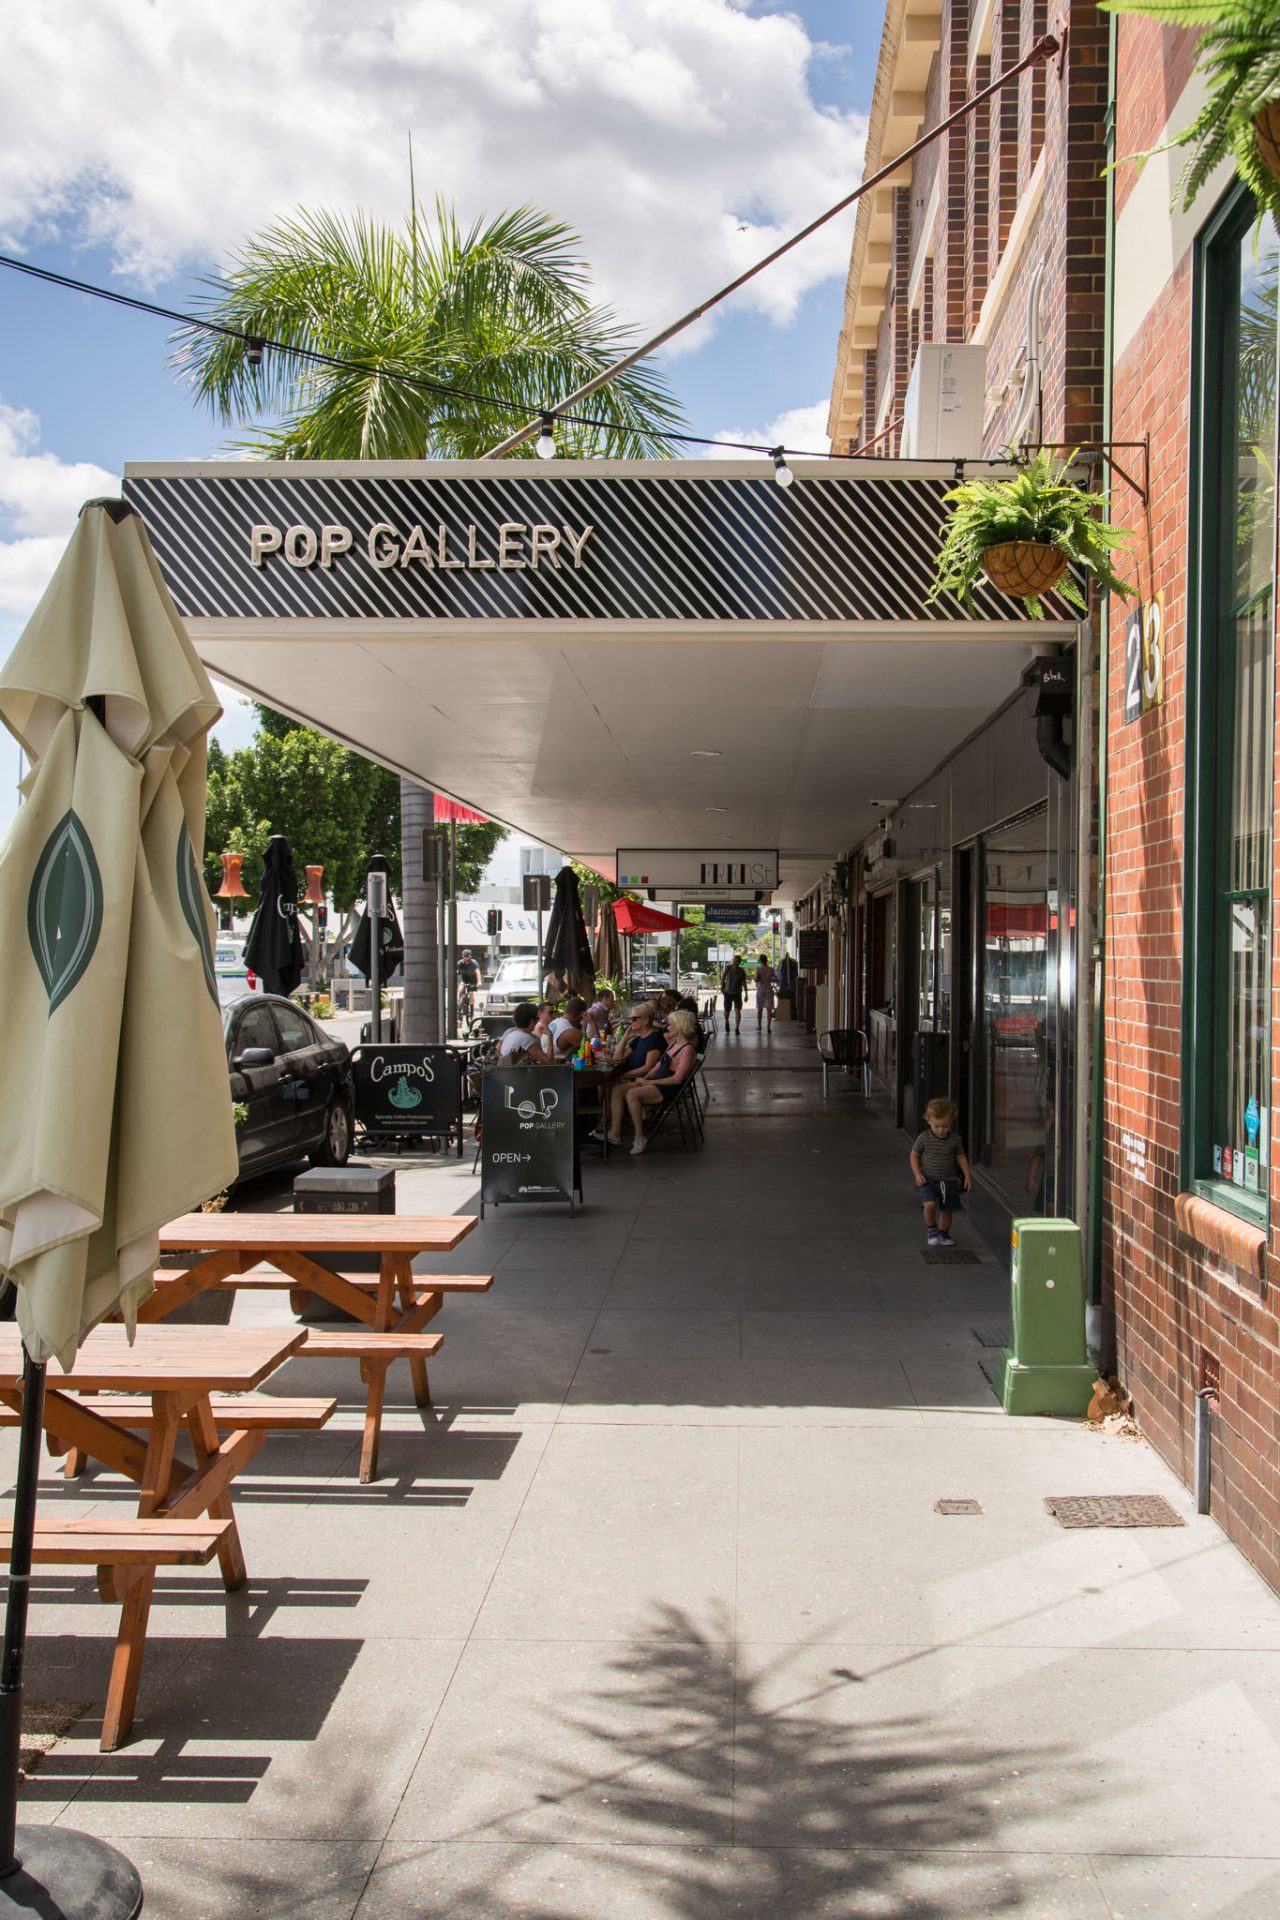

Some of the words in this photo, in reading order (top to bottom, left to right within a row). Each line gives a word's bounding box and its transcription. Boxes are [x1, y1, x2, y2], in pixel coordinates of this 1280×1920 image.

[250, 524, 353, 567] POP
[367, 523, 594, 569] GALLERY
[519, 1122, 534, 1130] POP
[535, 1121, 565, 1130] GALLERY
[492, 1152, 521, 1163] OPEN
